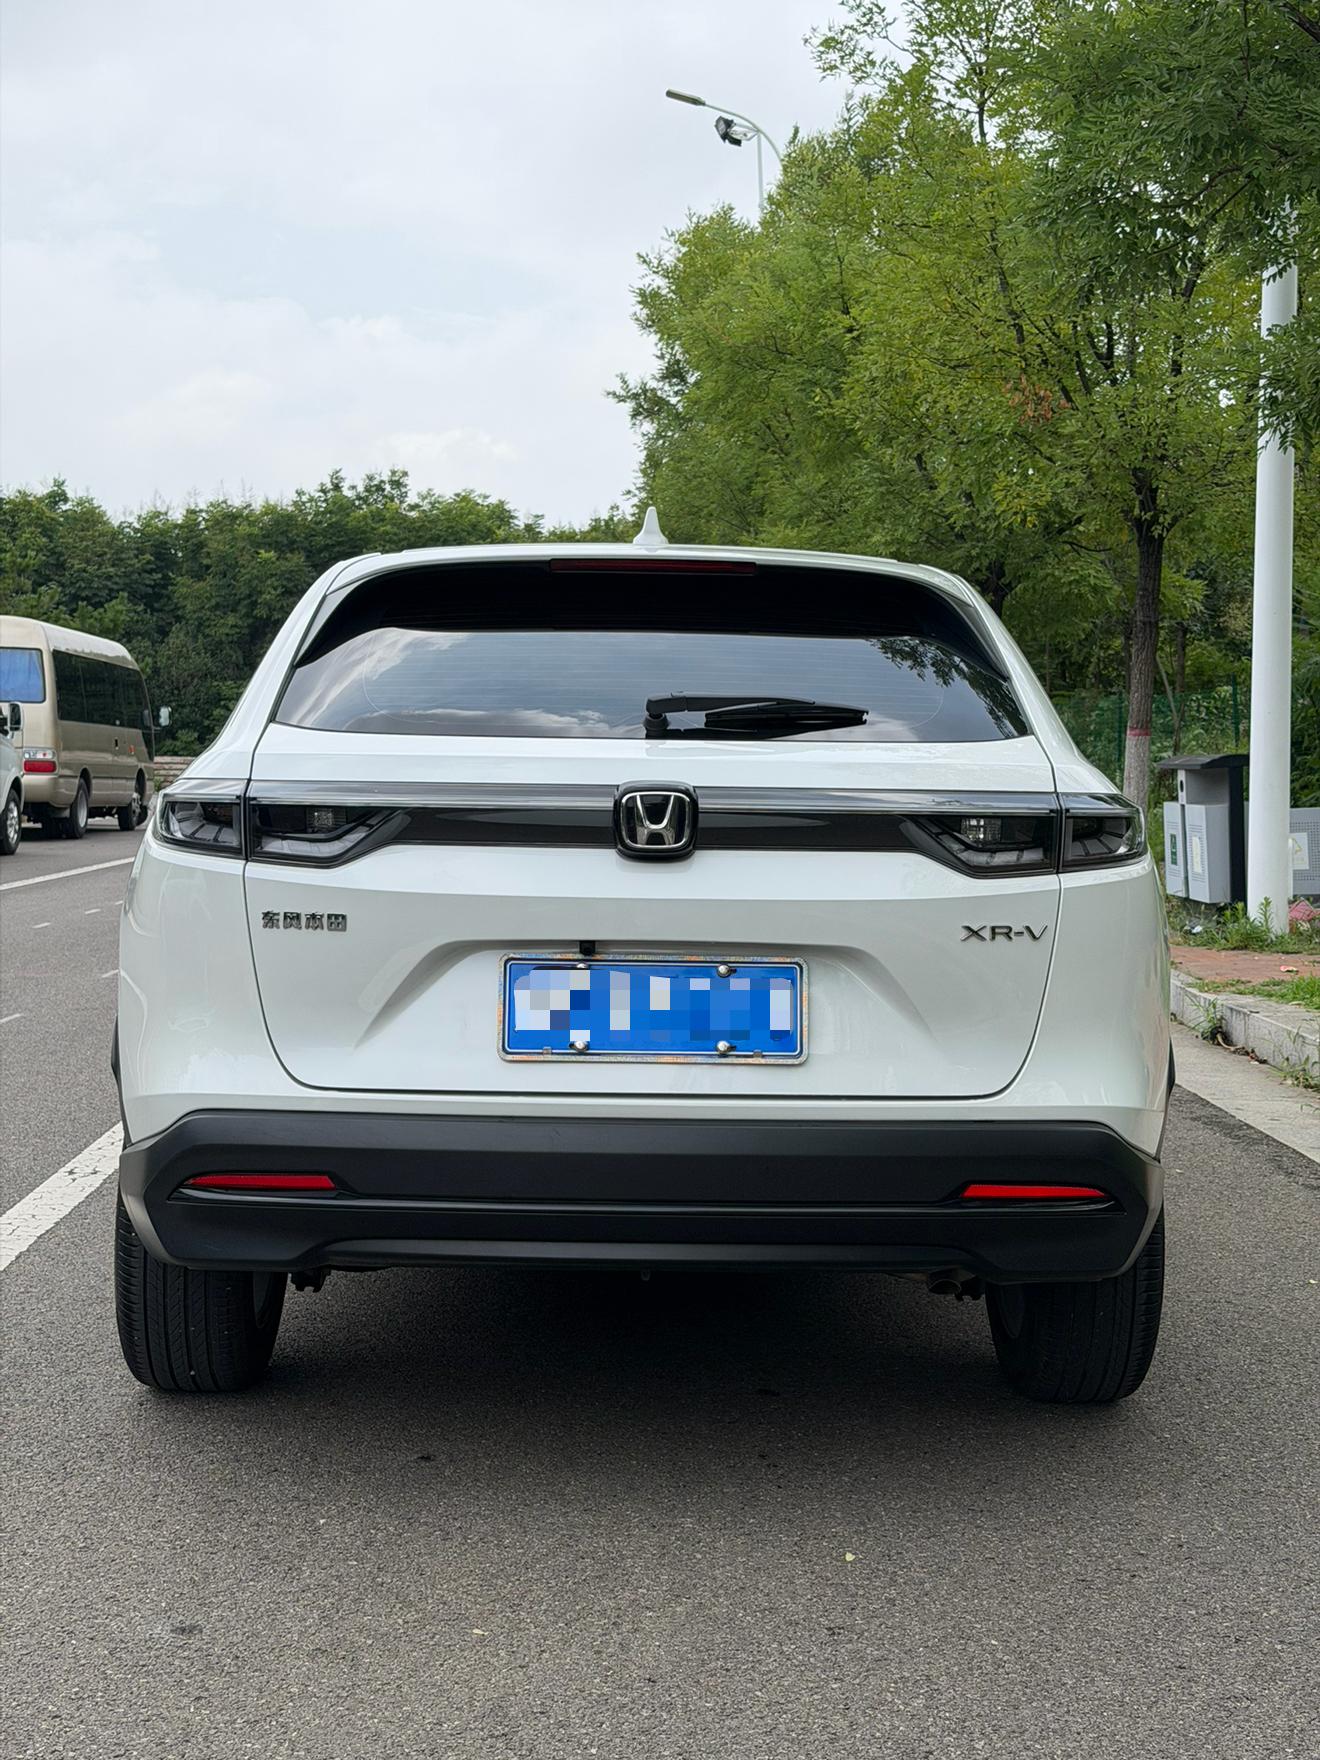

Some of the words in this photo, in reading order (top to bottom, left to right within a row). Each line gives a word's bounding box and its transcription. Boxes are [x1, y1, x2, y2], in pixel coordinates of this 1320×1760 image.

[262, 910, 347, 932] 东风本田
[960, 925, 1048, 942] XR-V
